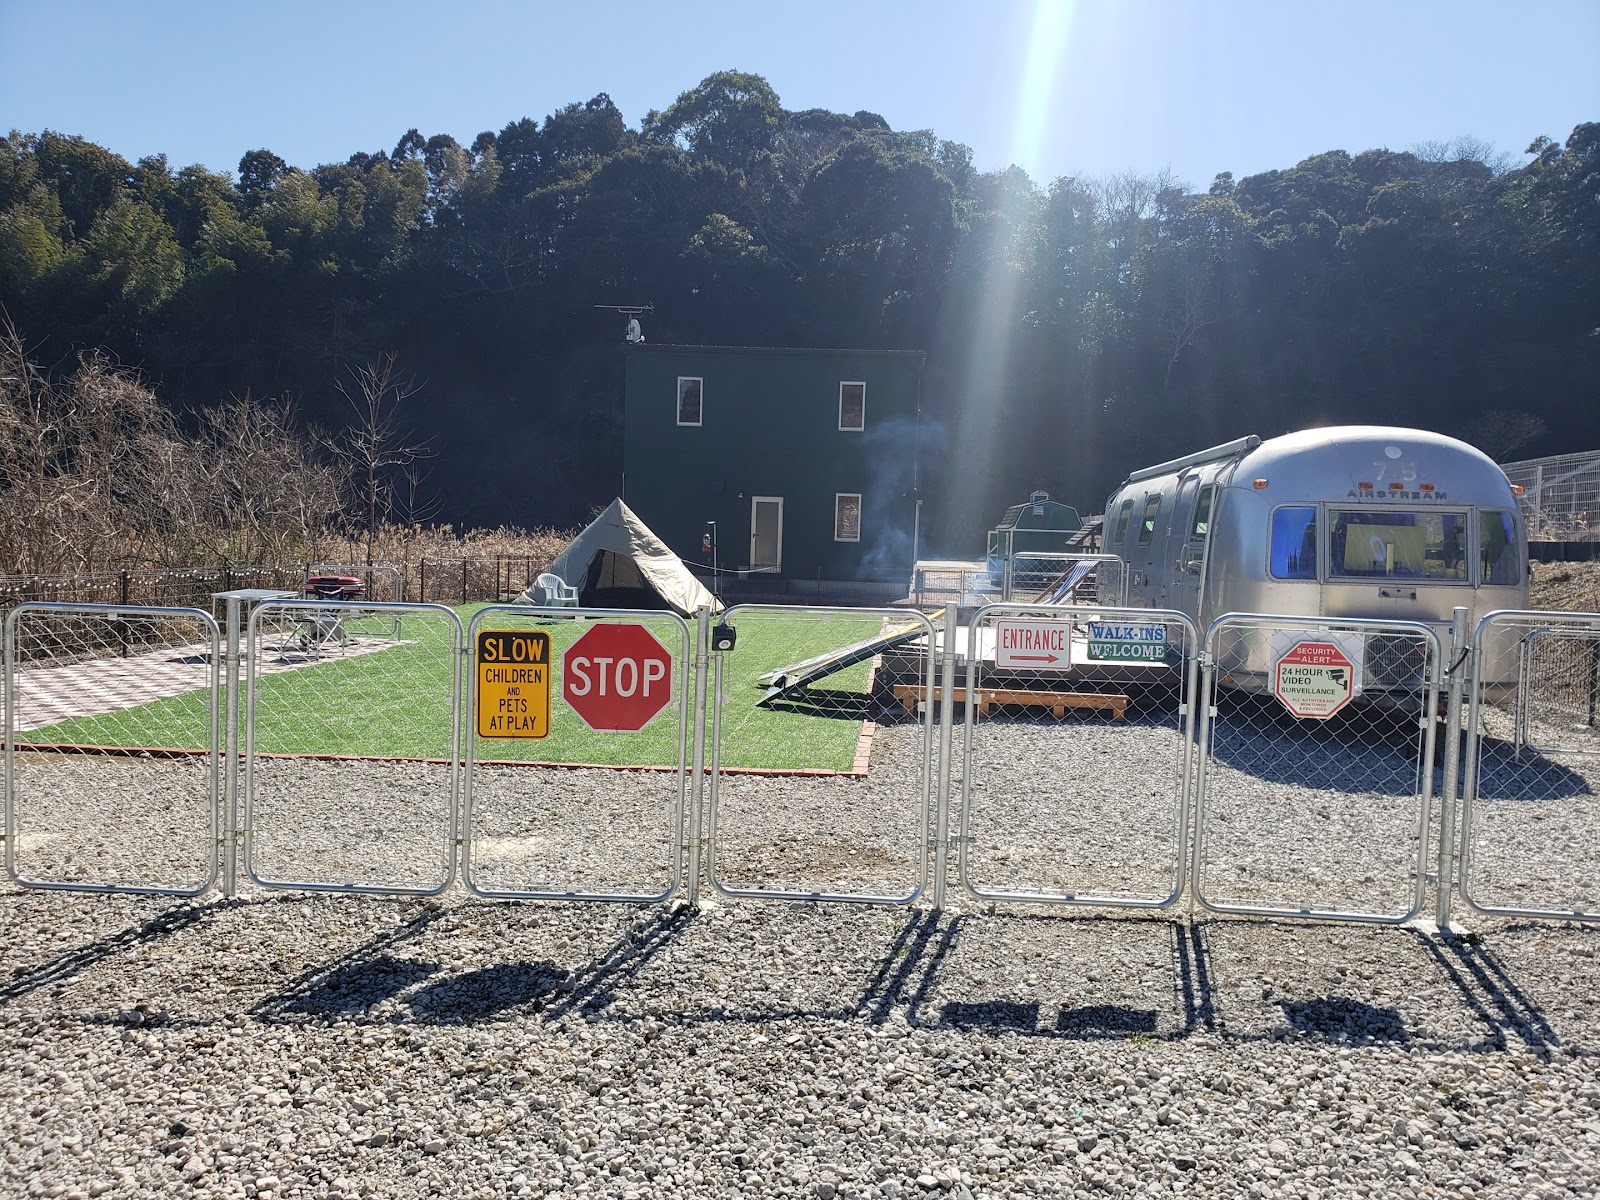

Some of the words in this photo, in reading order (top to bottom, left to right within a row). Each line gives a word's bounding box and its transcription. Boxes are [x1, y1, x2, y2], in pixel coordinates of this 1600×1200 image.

[1347, 489, 1448, 500] AIRSTREAM
[1003, 628, 1064, 651] ENTRANCE
[1091, 625, 1164, 641] WALK-INS
[484, 638, 543, 662] SLOW
[1090, 644, 1165, 658] WELCOME
[1297, 647, 1336, 655] SECURITY
[486, 669, 542, 684] CHILDREN
[570, 656, 665, 698] STOP
[1282, 667, 1293, 675] 24
[1295, 668, 1323, 676] HOUR
[1282, 677, 1311, 685] VIDEO
[507, 687, 520, 696] AND
[1281, 687, 1335, 695] SURVEILLANCE
[499, 699, 527, 713] PETS
[490, 716, 503, 730] AT
[508, 716, 536, 730] PLAY
